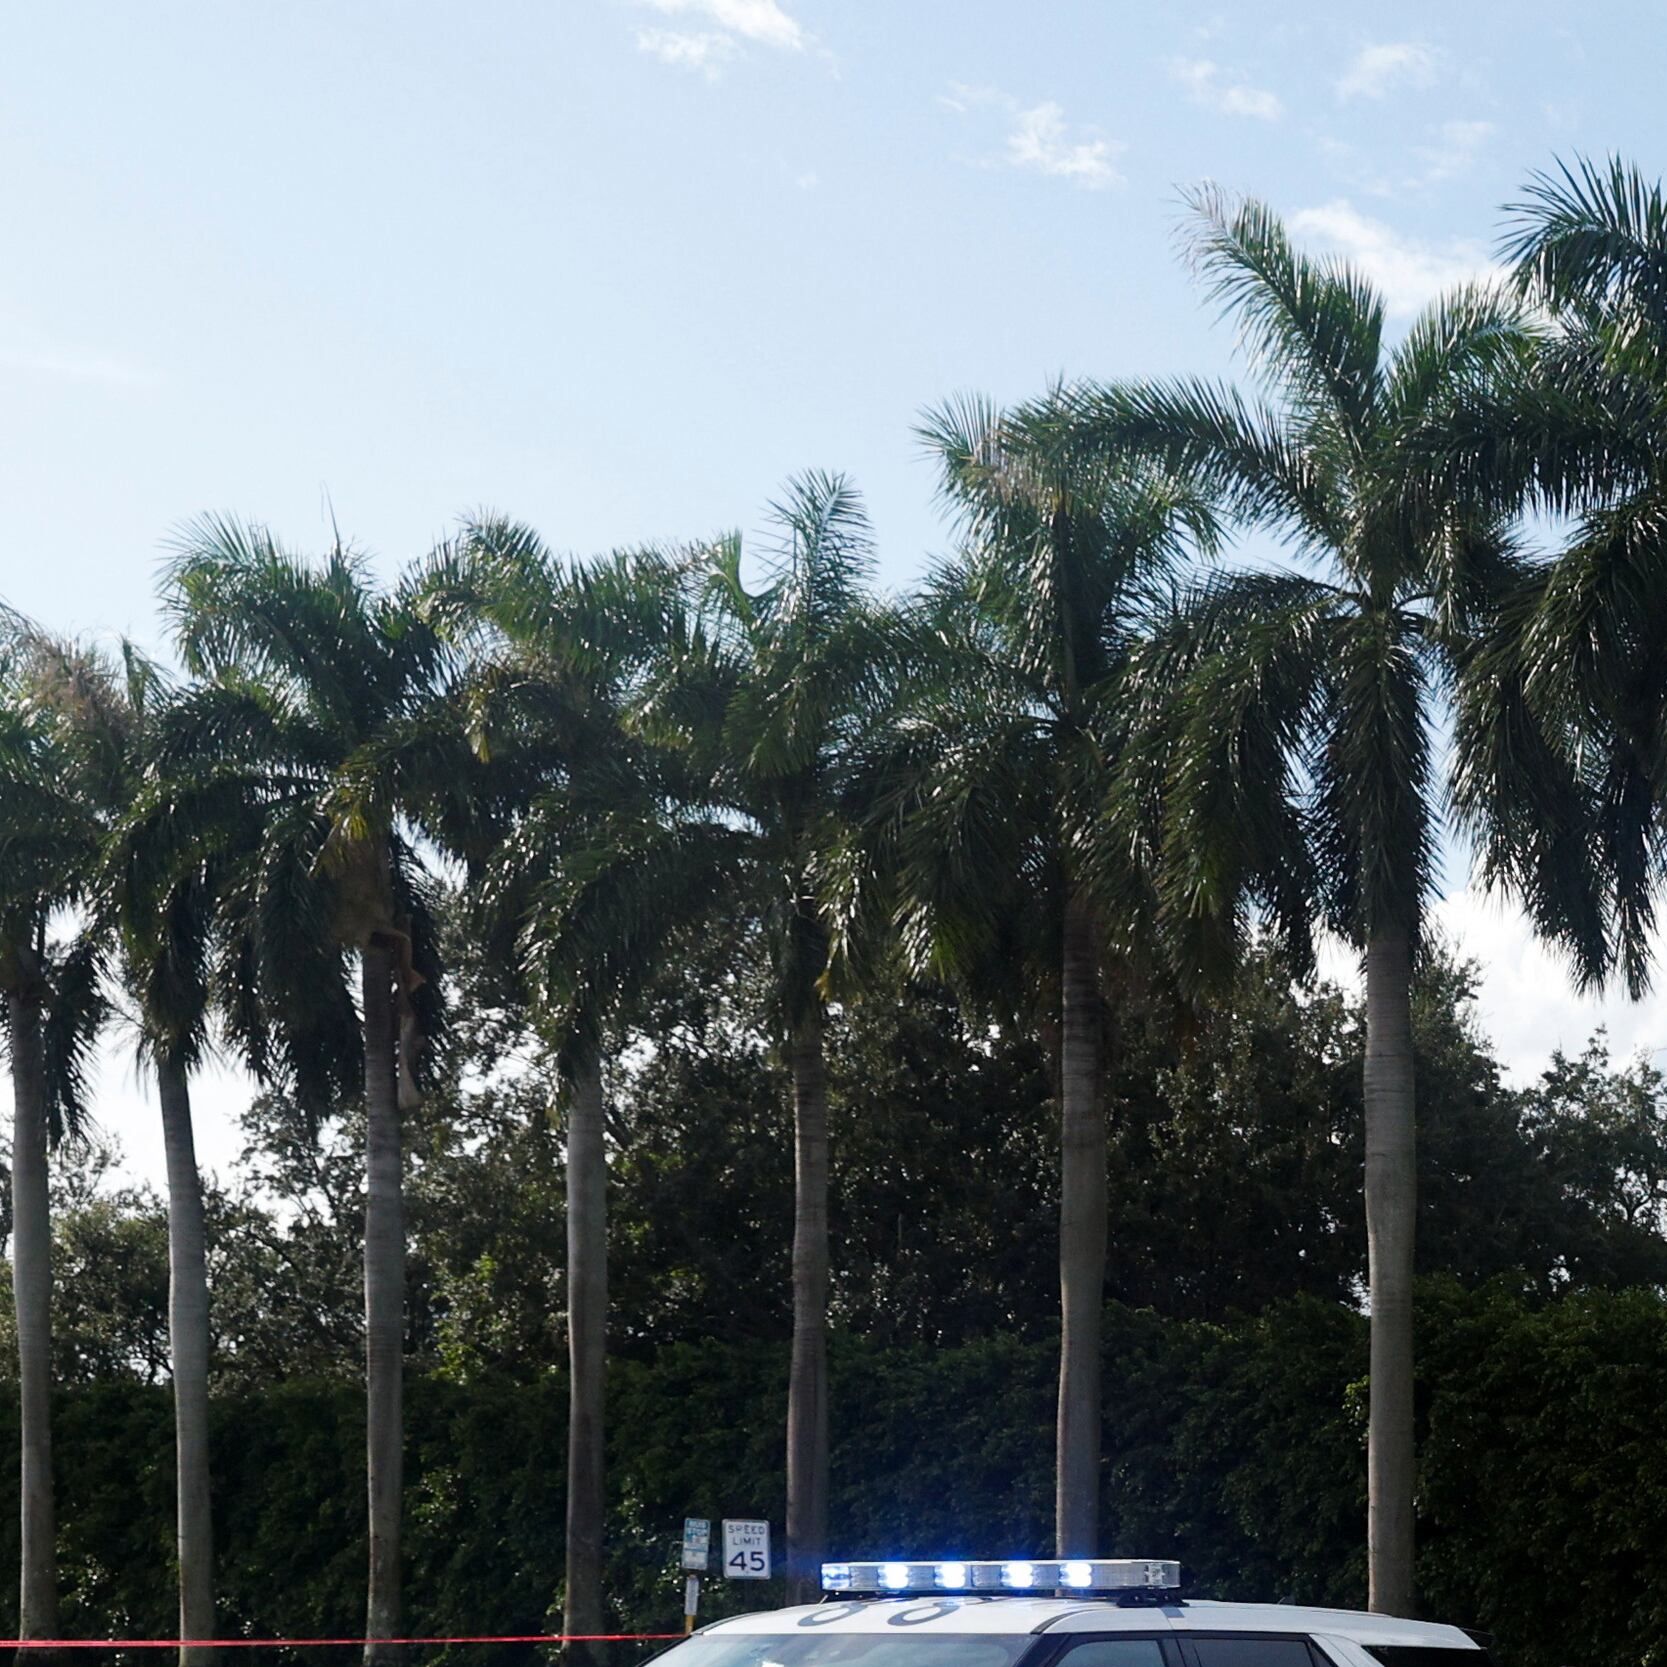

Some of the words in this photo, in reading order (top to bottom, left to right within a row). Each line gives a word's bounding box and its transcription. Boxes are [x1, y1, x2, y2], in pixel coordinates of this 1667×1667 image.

[728, 1525, 765, 1535] SPEED
[732, 1537, 761, 1546] LIMIT
[729, 1550, 766, 1571] 45
